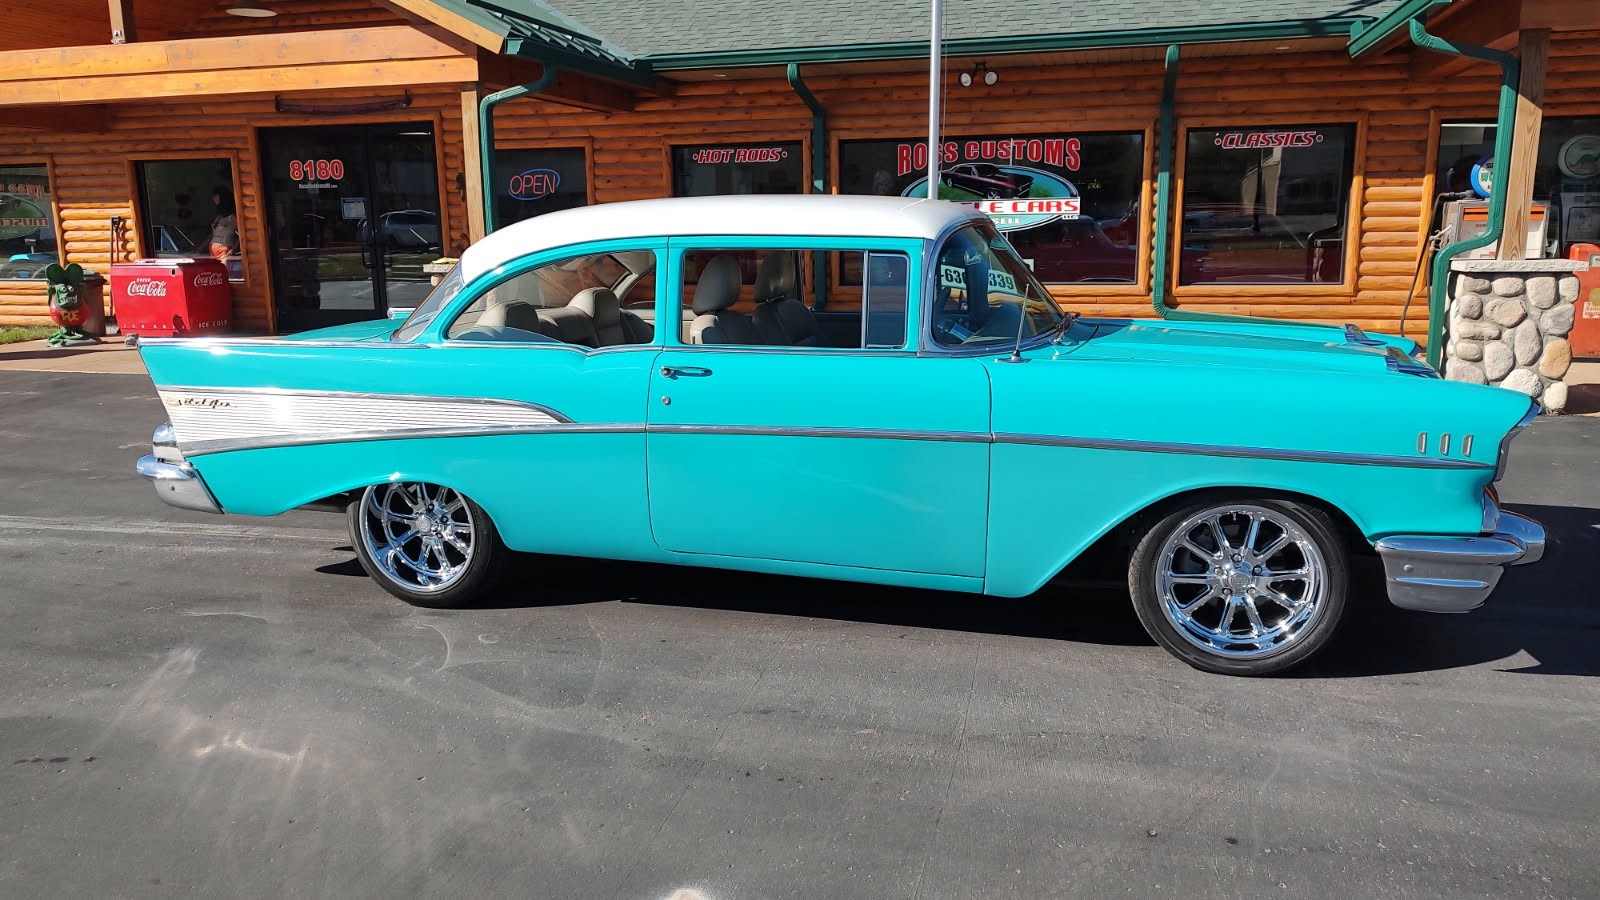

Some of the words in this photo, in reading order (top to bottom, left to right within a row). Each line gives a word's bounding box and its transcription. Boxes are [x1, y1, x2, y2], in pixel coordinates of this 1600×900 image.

[1222, 131, 1316, 149] CLASSICS
[698, 149, 734, 163] HOT
[735, 148, 782, 163] RODS
[965, 138, 1081, 172] CUSTOMS
[289, 159, 344, 181] 8180
[509, 174, 556, 195] OPEN
[1012, 200, 1079, 213] CARS
[127, 281, 166, 297] Coca-Cola
